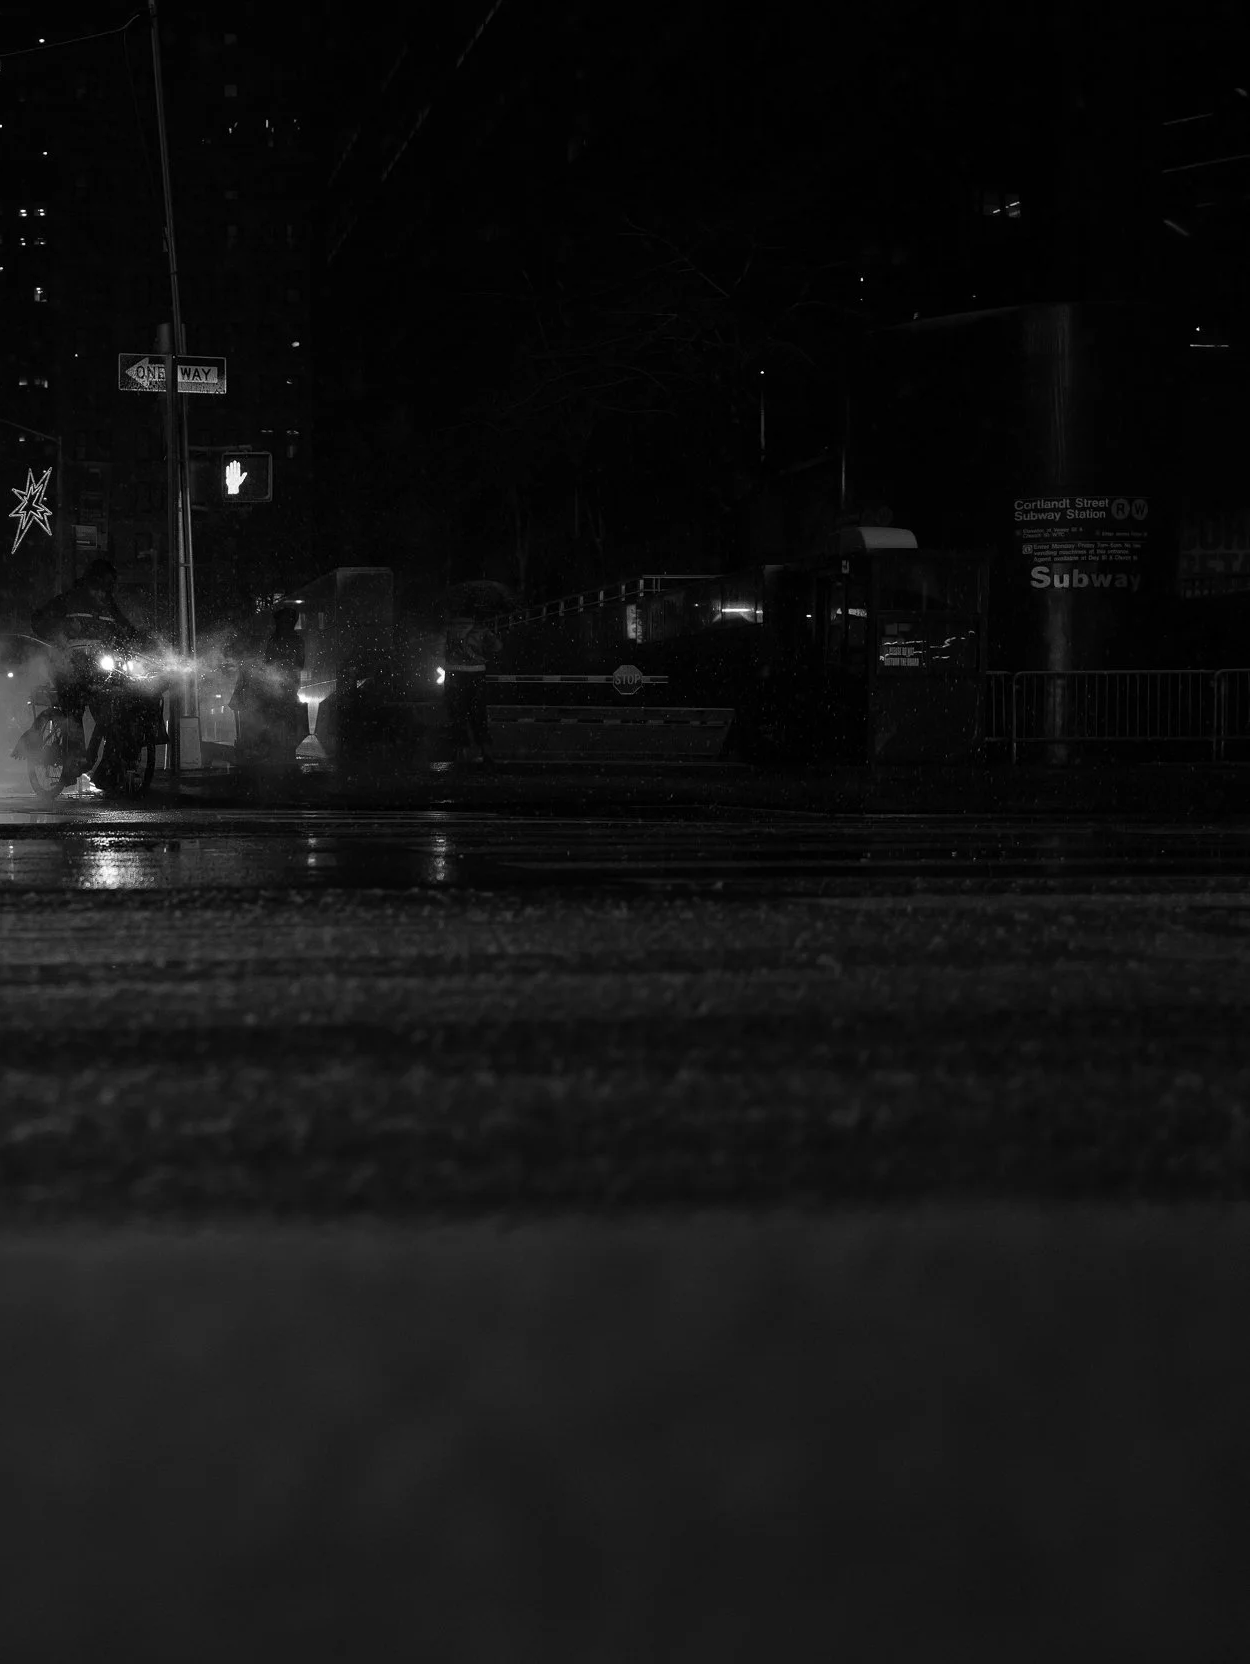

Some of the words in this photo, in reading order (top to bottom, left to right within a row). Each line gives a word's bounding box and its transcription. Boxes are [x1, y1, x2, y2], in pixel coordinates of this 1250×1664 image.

[136, 365, 166, 380] ONE
[181, 367, 211, 381] WAY
[1014, 499, 1070, 510] Cortlandt
[1075, 498, 1109, 508] Street
[1014, 511, 1061, 522] Subway
[1066, 509, 1106, 519] Station
[1030, 566, 1141, 592] Subway
[615, 673, 641, 685] STOP
